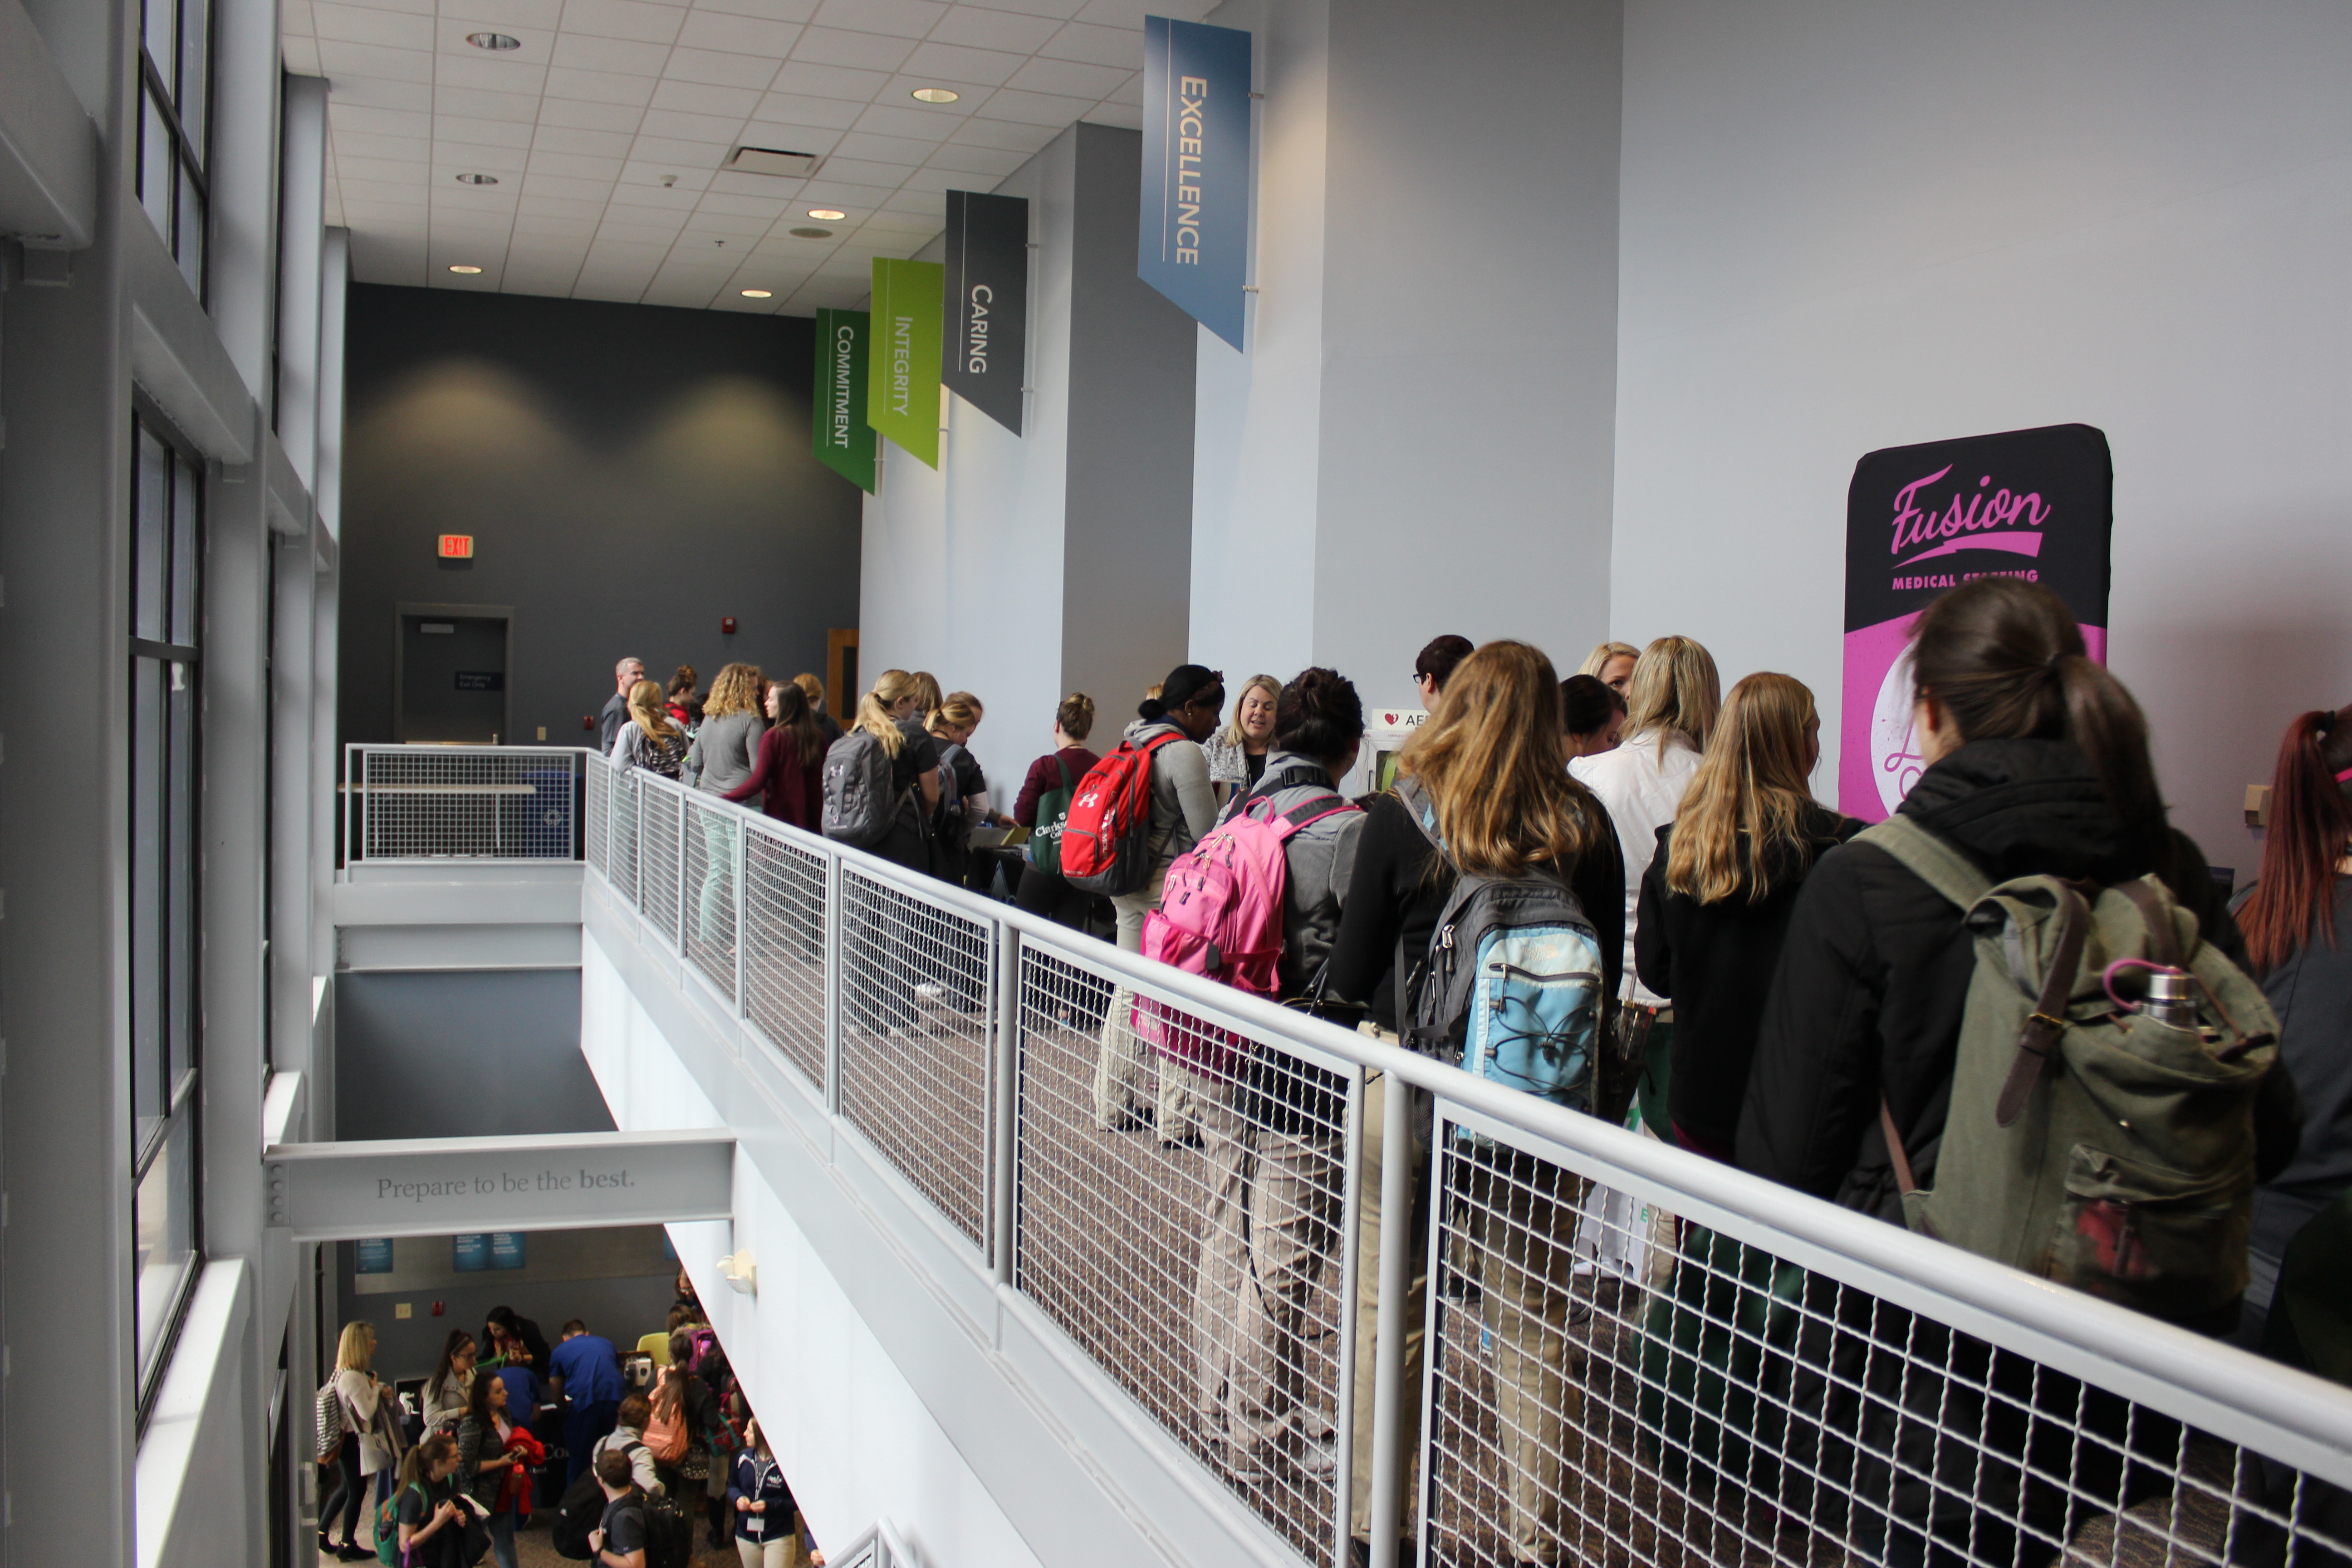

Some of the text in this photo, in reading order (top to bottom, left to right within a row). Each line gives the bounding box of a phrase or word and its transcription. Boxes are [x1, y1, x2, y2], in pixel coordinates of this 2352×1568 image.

[1176, 75, 1207, 265] EXCELLENCE
[892, 316, 913, 416] INTEGRITY
[968, 284, 993, 374] CARING
[834, 326, 854, 449] COMMITMENT
[443, 536, 469, 556] EXIT
[1891, 463, 2051, 555] Fusion
[1892, 574, 1956, 590] MEDICAL
[1406, 715, 1430, 725] AE
[377, 1169, 636, 1203] Prepare to be the best.
